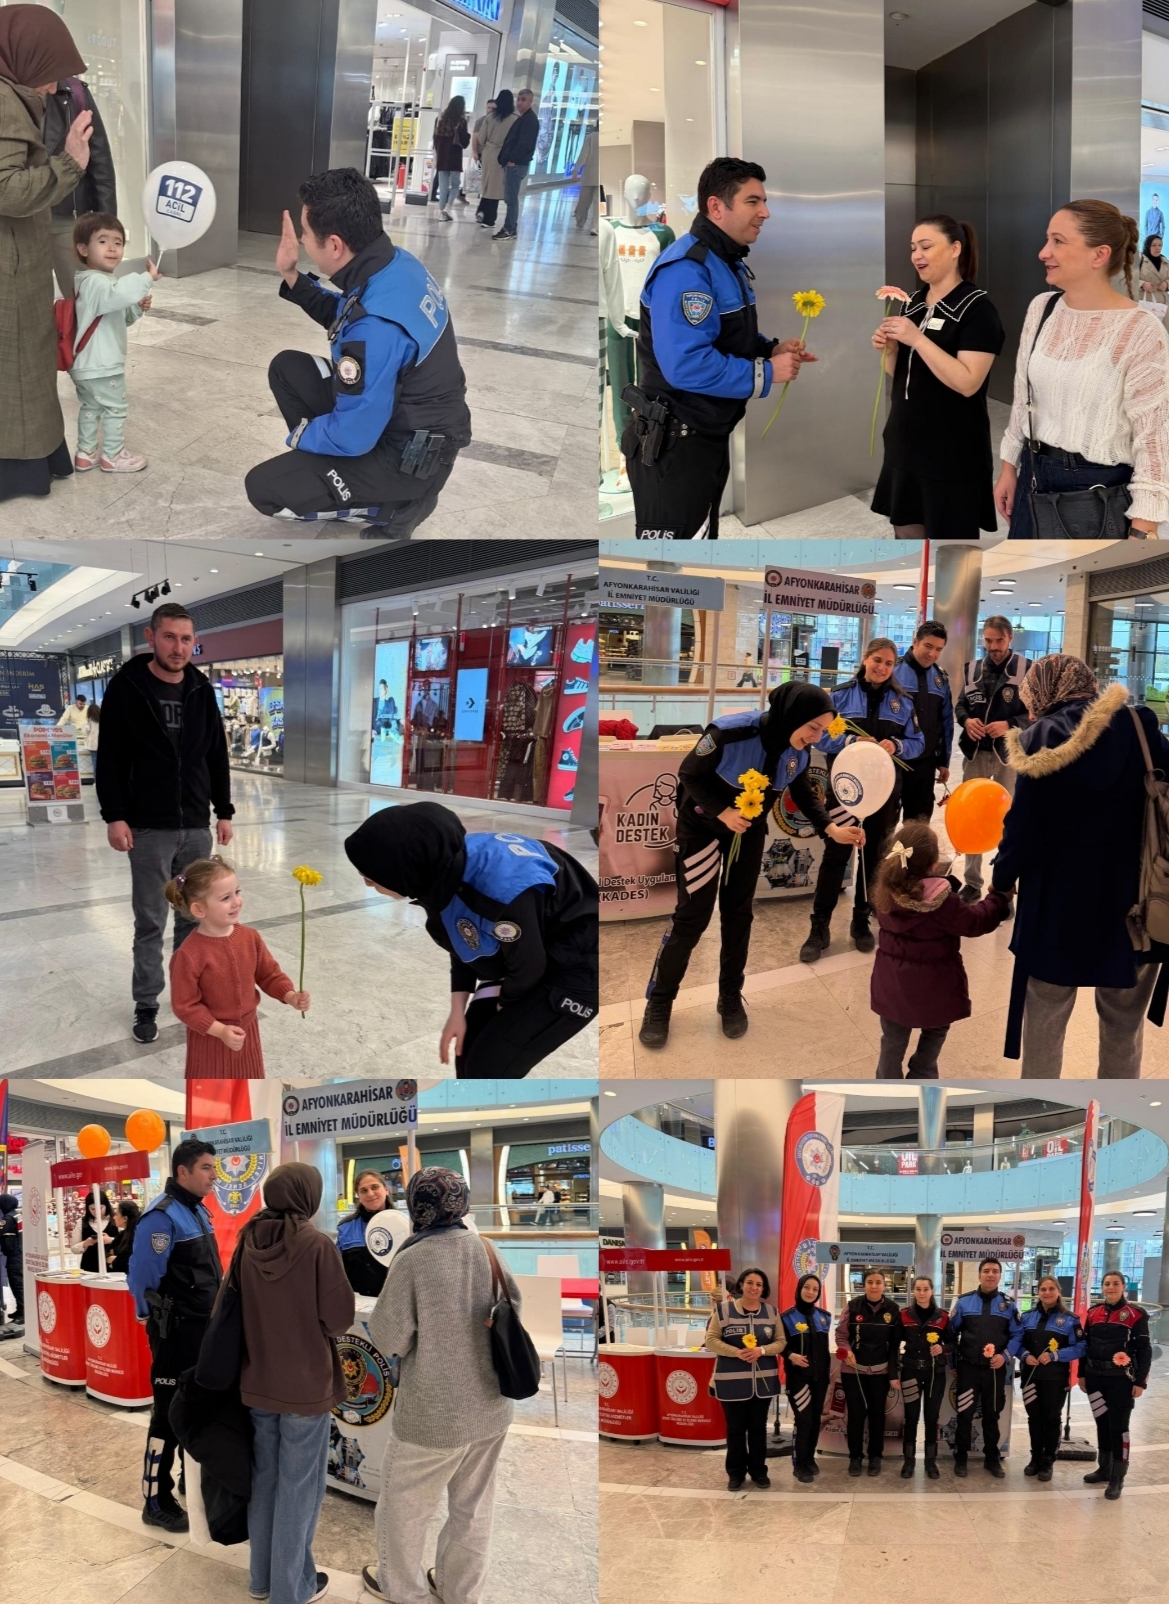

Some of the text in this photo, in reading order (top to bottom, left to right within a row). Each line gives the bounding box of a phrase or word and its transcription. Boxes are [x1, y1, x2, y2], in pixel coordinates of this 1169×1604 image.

[165, 179, 196, 203] 112
[603, 582, 670, 593] AFYONKARAHİSAR
[784, 576, 860, 595] AFYONKARAHİSAR
[608, 590, 694, 605] İL EMNİYET MÜDÜRLÜĞÜ
[764, 590, 874, 615] İL EMNİYET MÜDÜRLÜĞÜ
[617, 813, 659, 827] KADIN
[616, 828, 668, 843] DESTEK
[604, 876, 636, 886] Destek
[302, 1085, 393, 1111] AFYONKARAHİSAR
[285, 1105, 417, 1136] İL EMNİYET MÜDÜRLÜĞÜ
[954, 1236, 1011, 1245] AFYONKARAHİSAR
[940, 1248, 1024, 1259] İL EMNİYET MÜDÜRLÜĞÜ
[372, 1353, 390, 1377] POLİS
